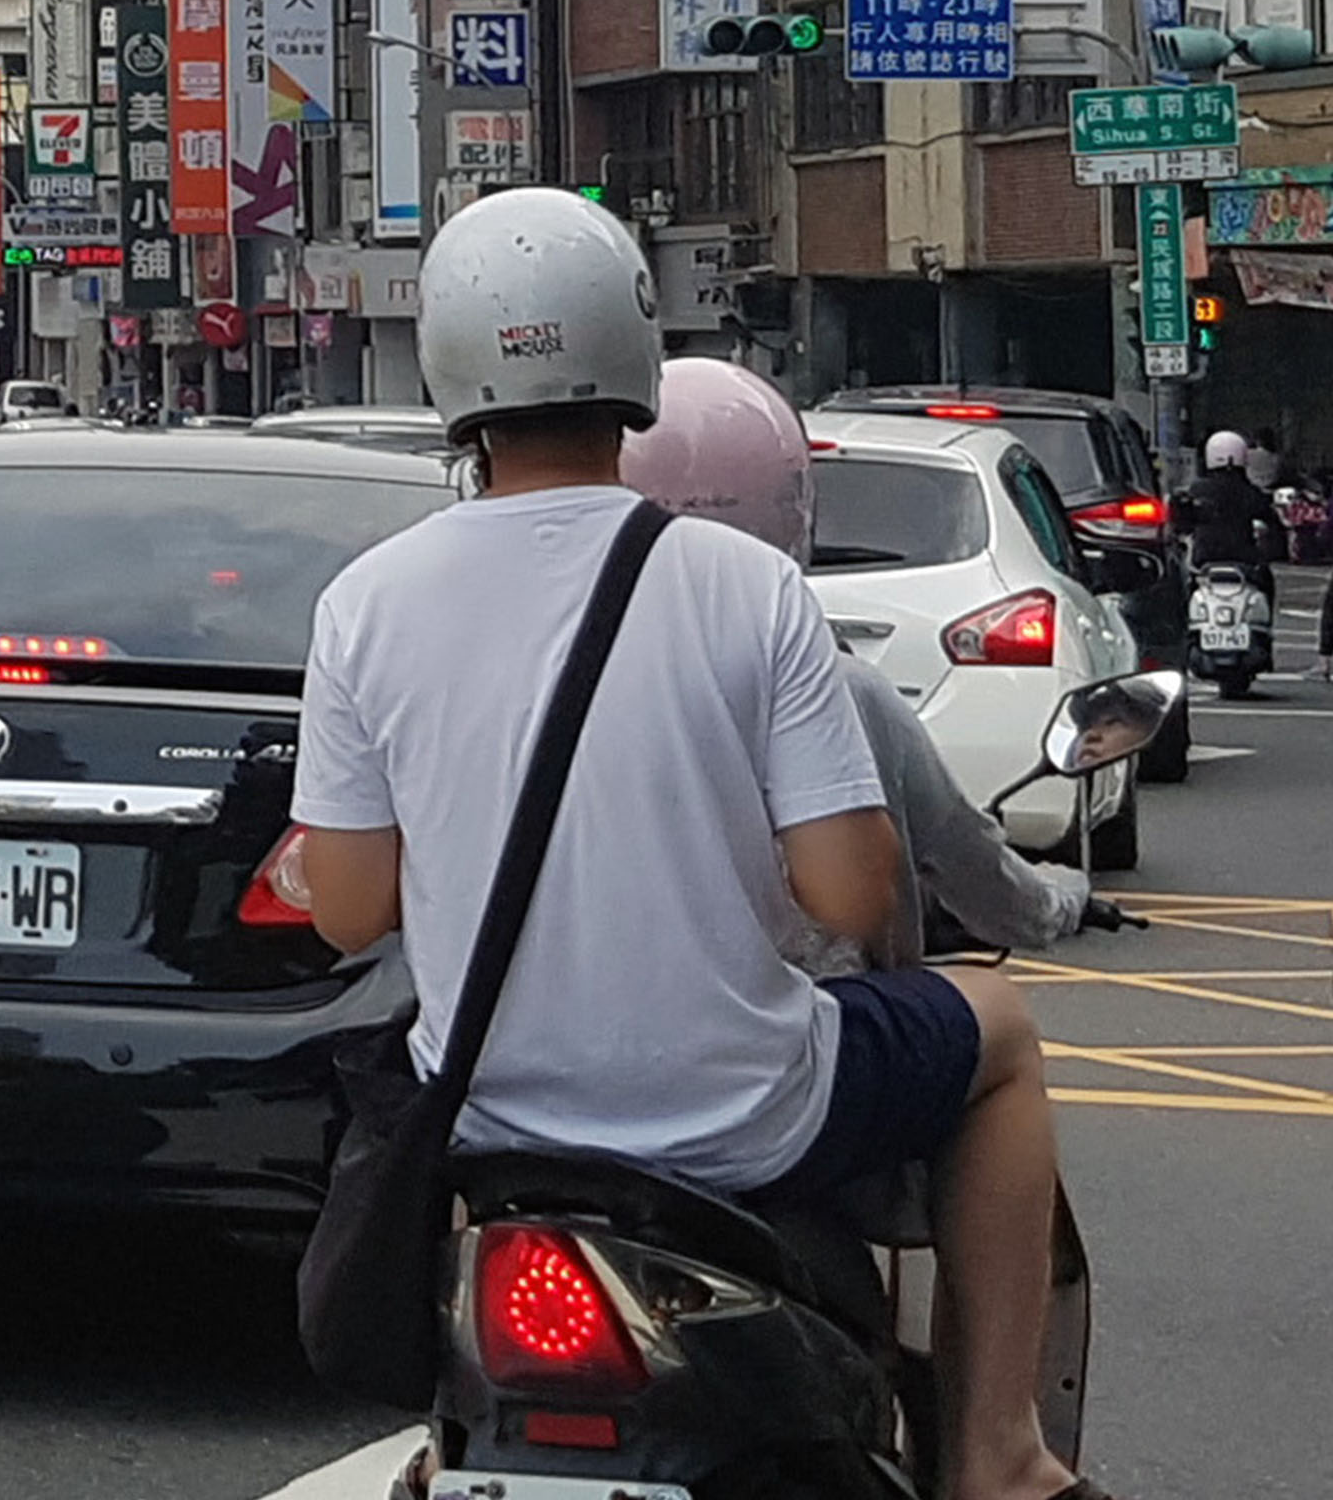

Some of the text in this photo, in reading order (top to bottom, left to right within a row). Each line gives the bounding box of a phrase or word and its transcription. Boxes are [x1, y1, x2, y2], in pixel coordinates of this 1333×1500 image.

[851, 20, 1008, 45] 行人專用時相
[1085, 91, 1221, 123] 西華南街
[1091, 128, 1148, 145] Sihua
[502, 337, 565, 361] MOUSE
[158, 745, 246, 760] COROLLA
